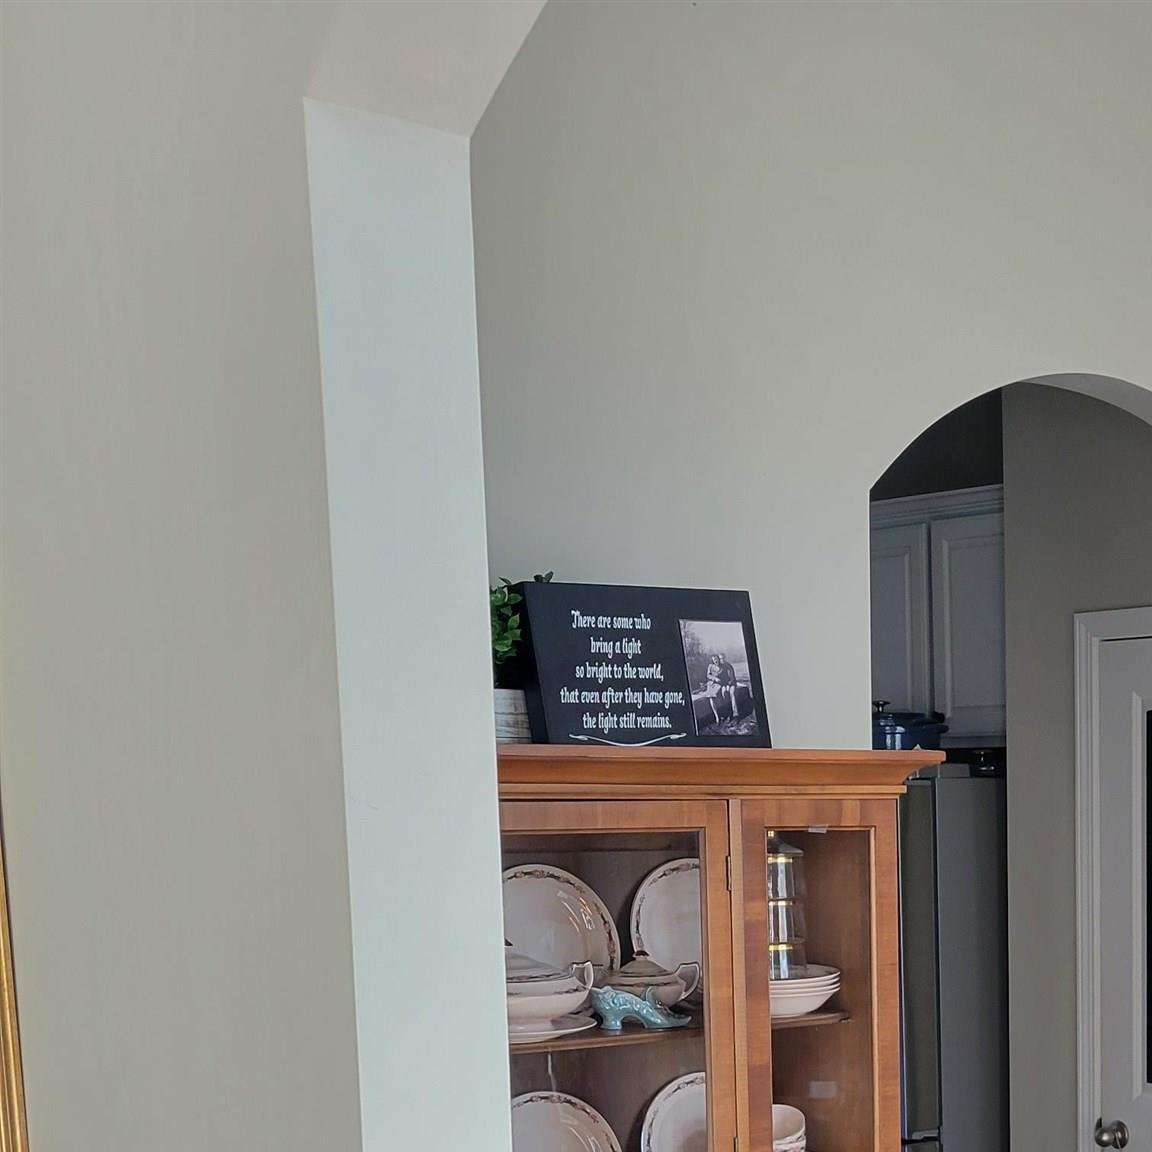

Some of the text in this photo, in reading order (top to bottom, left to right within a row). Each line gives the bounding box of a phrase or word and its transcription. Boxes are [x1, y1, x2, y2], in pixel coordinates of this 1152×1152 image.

[571, 609, 651, 630] There are some who
[590, 636, 642, 659] bring a light
[575, 662, 664, 684] so bright to the world,
[560, 686, 685, 709] that even after they have gone,
[582, 712, 672, 734] the light still remains.
